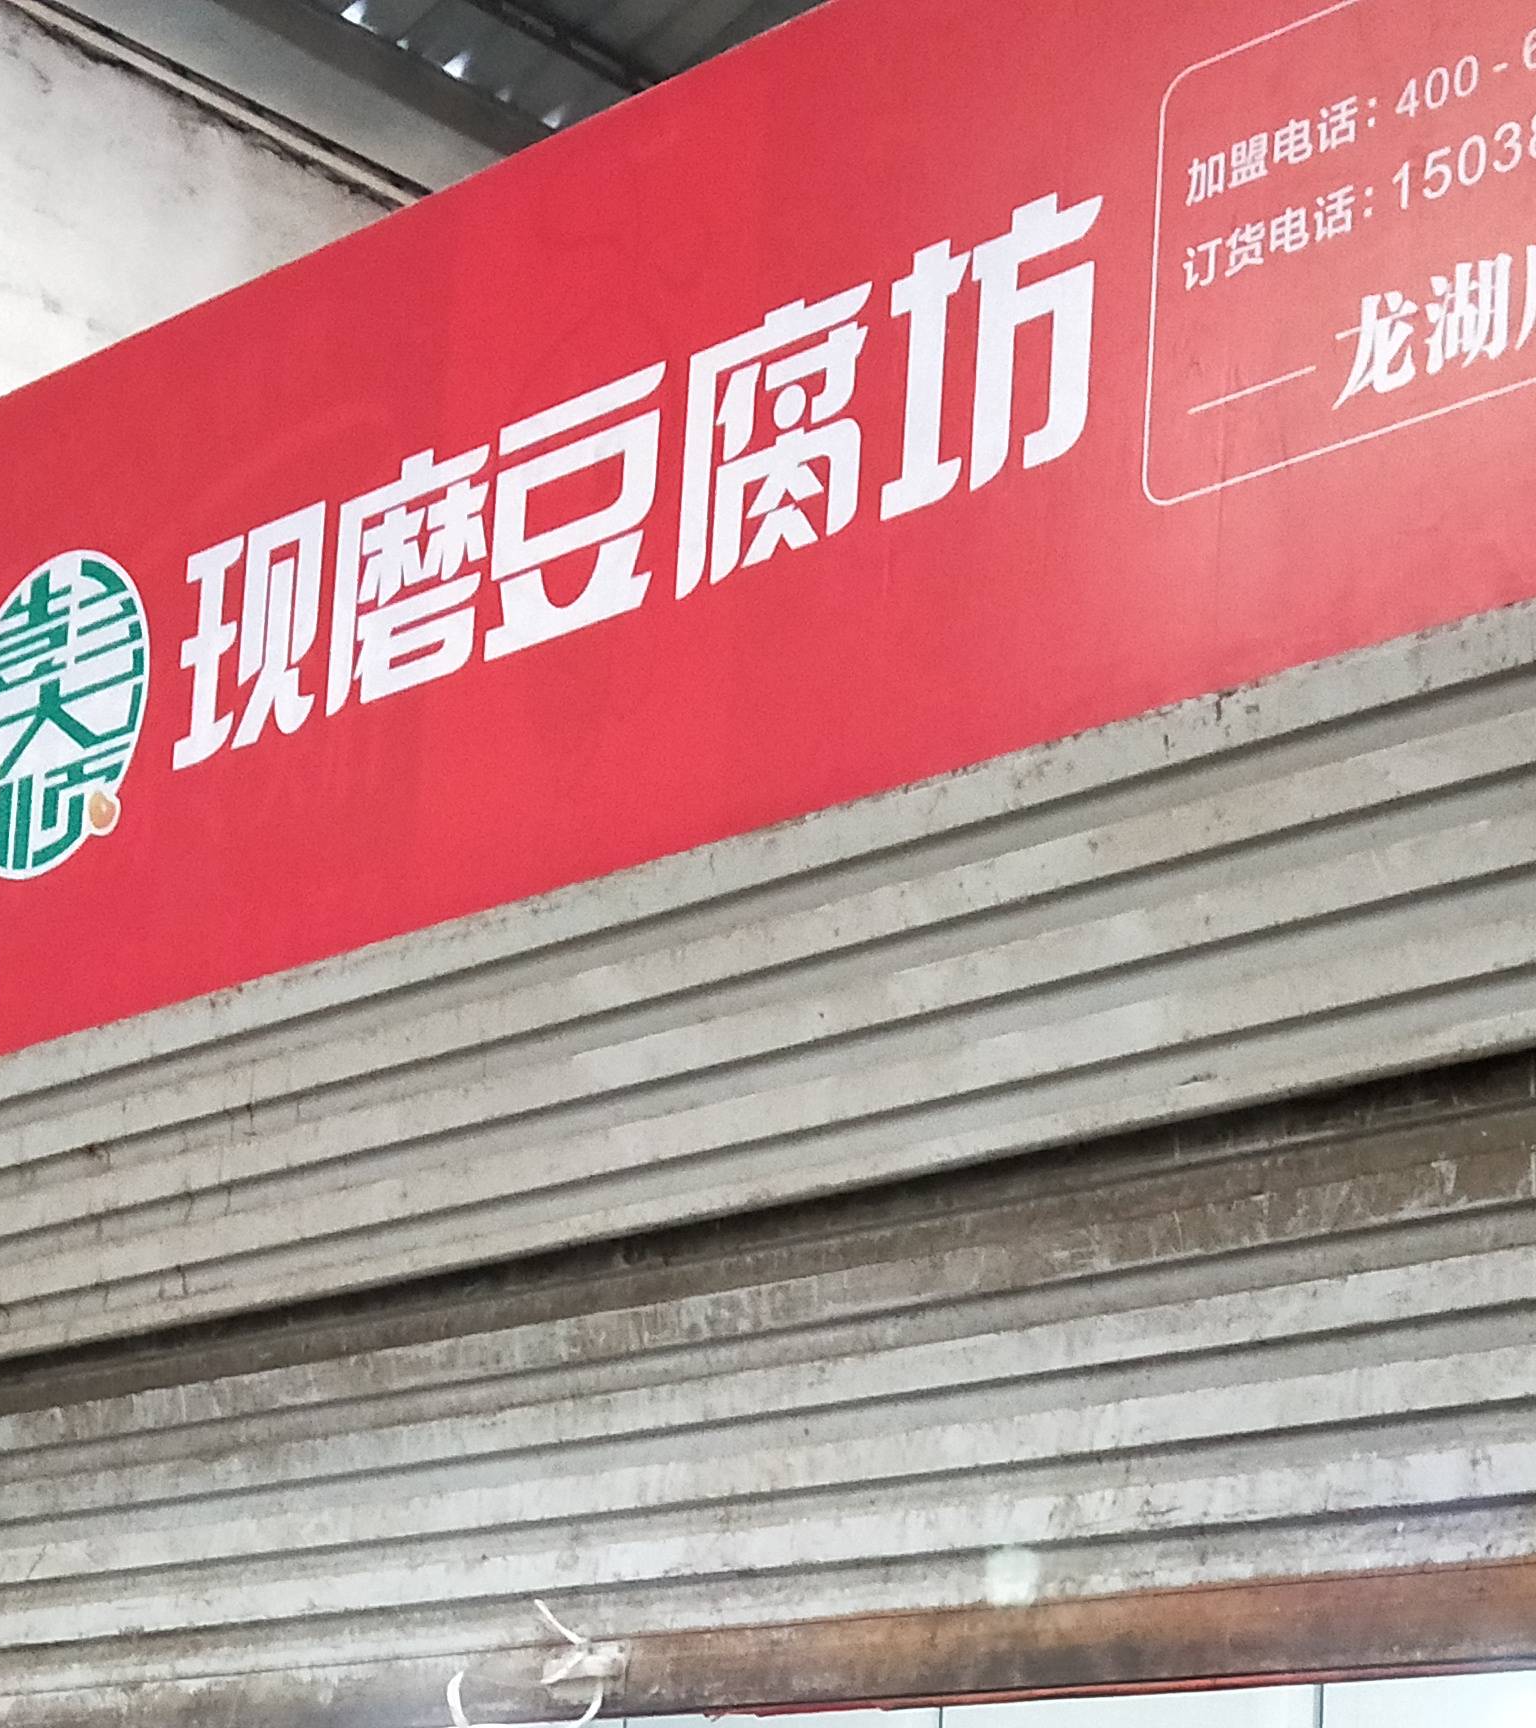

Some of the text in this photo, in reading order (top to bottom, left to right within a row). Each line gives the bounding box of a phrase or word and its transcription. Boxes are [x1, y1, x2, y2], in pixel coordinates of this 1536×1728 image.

[172, 191, 1103, 770] 现磨豆腐坊
